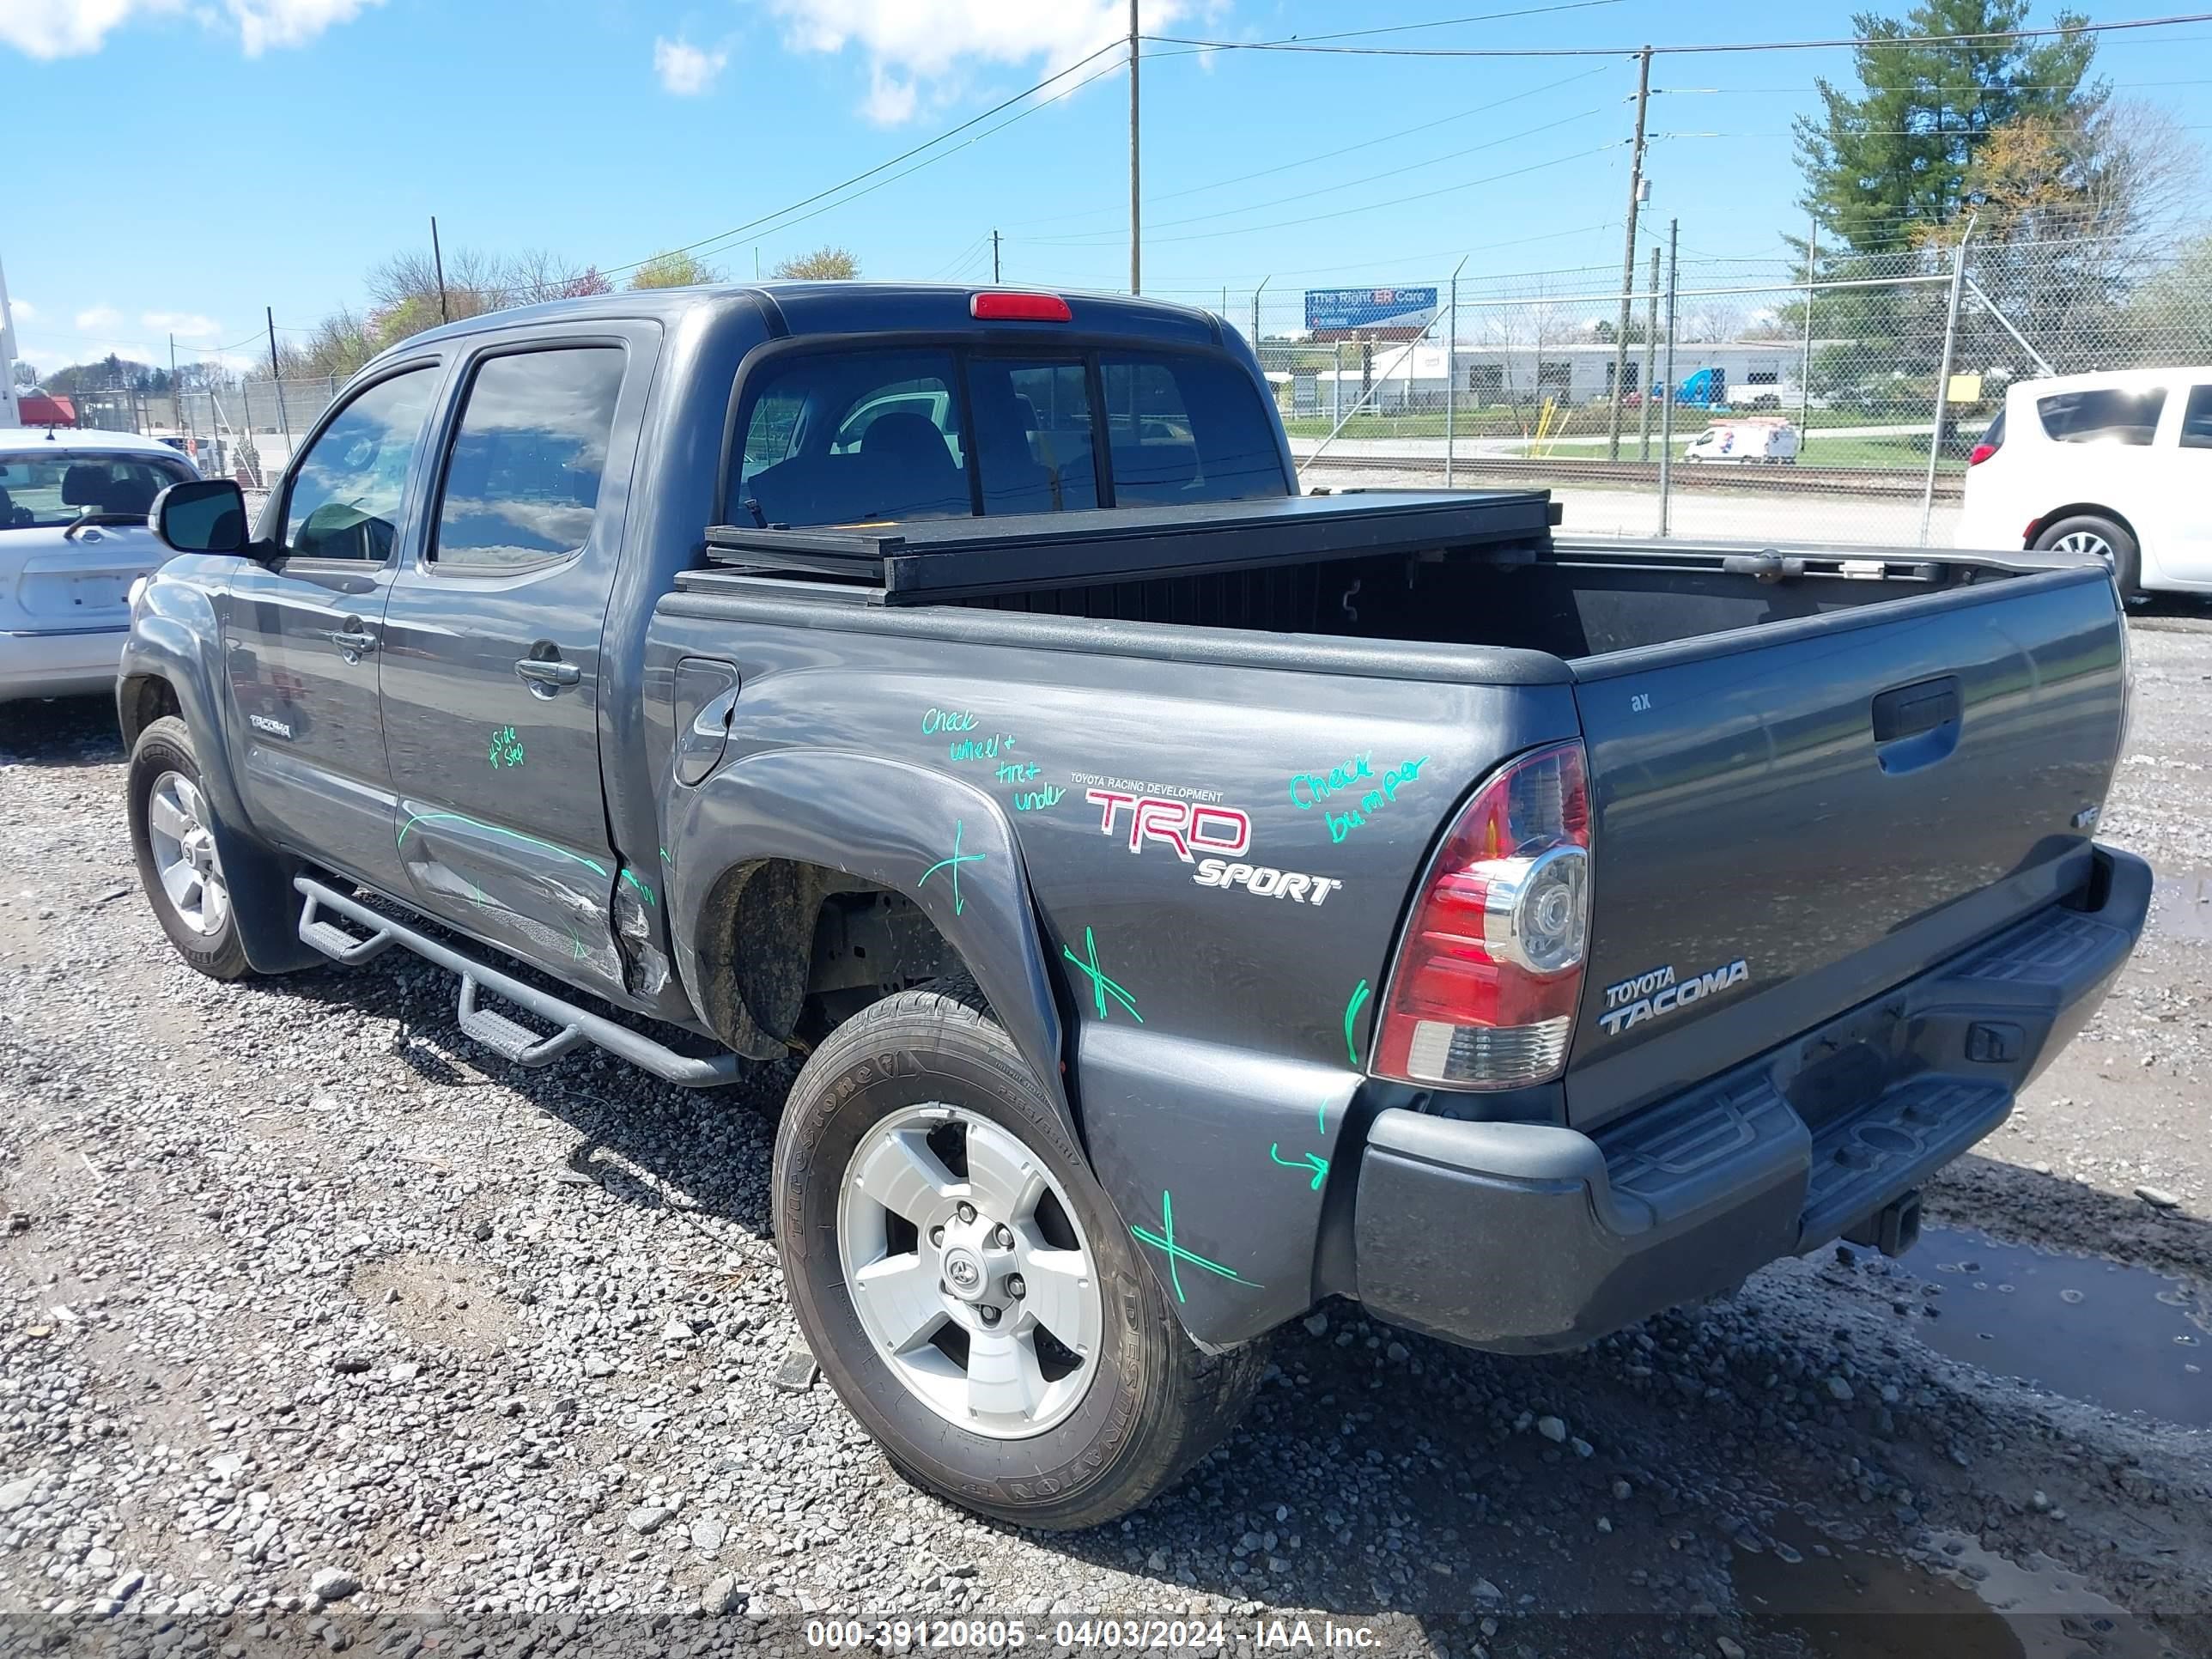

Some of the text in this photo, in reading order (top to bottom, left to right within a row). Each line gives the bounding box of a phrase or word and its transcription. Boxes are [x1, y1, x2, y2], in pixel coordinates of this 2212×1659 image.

[1340, 290, 1373, 305] Right
[1375, 290, 1392, 301] ER
[1395, 290, 1425, 301] Care
[922, 708, 979, 734] Check
[1071, 772, 1224, 803] TOYOTA RACING DEVELOPMENT
[1291, 750, 1375, 809] Check
[1085, 787, 1251, 864] TRD
[1192, 859, 1344, 906] SPORT
[1599, 959, 1750, 1036] TACOMA
[1607, 965, 1675, 1008] TOYOTA
